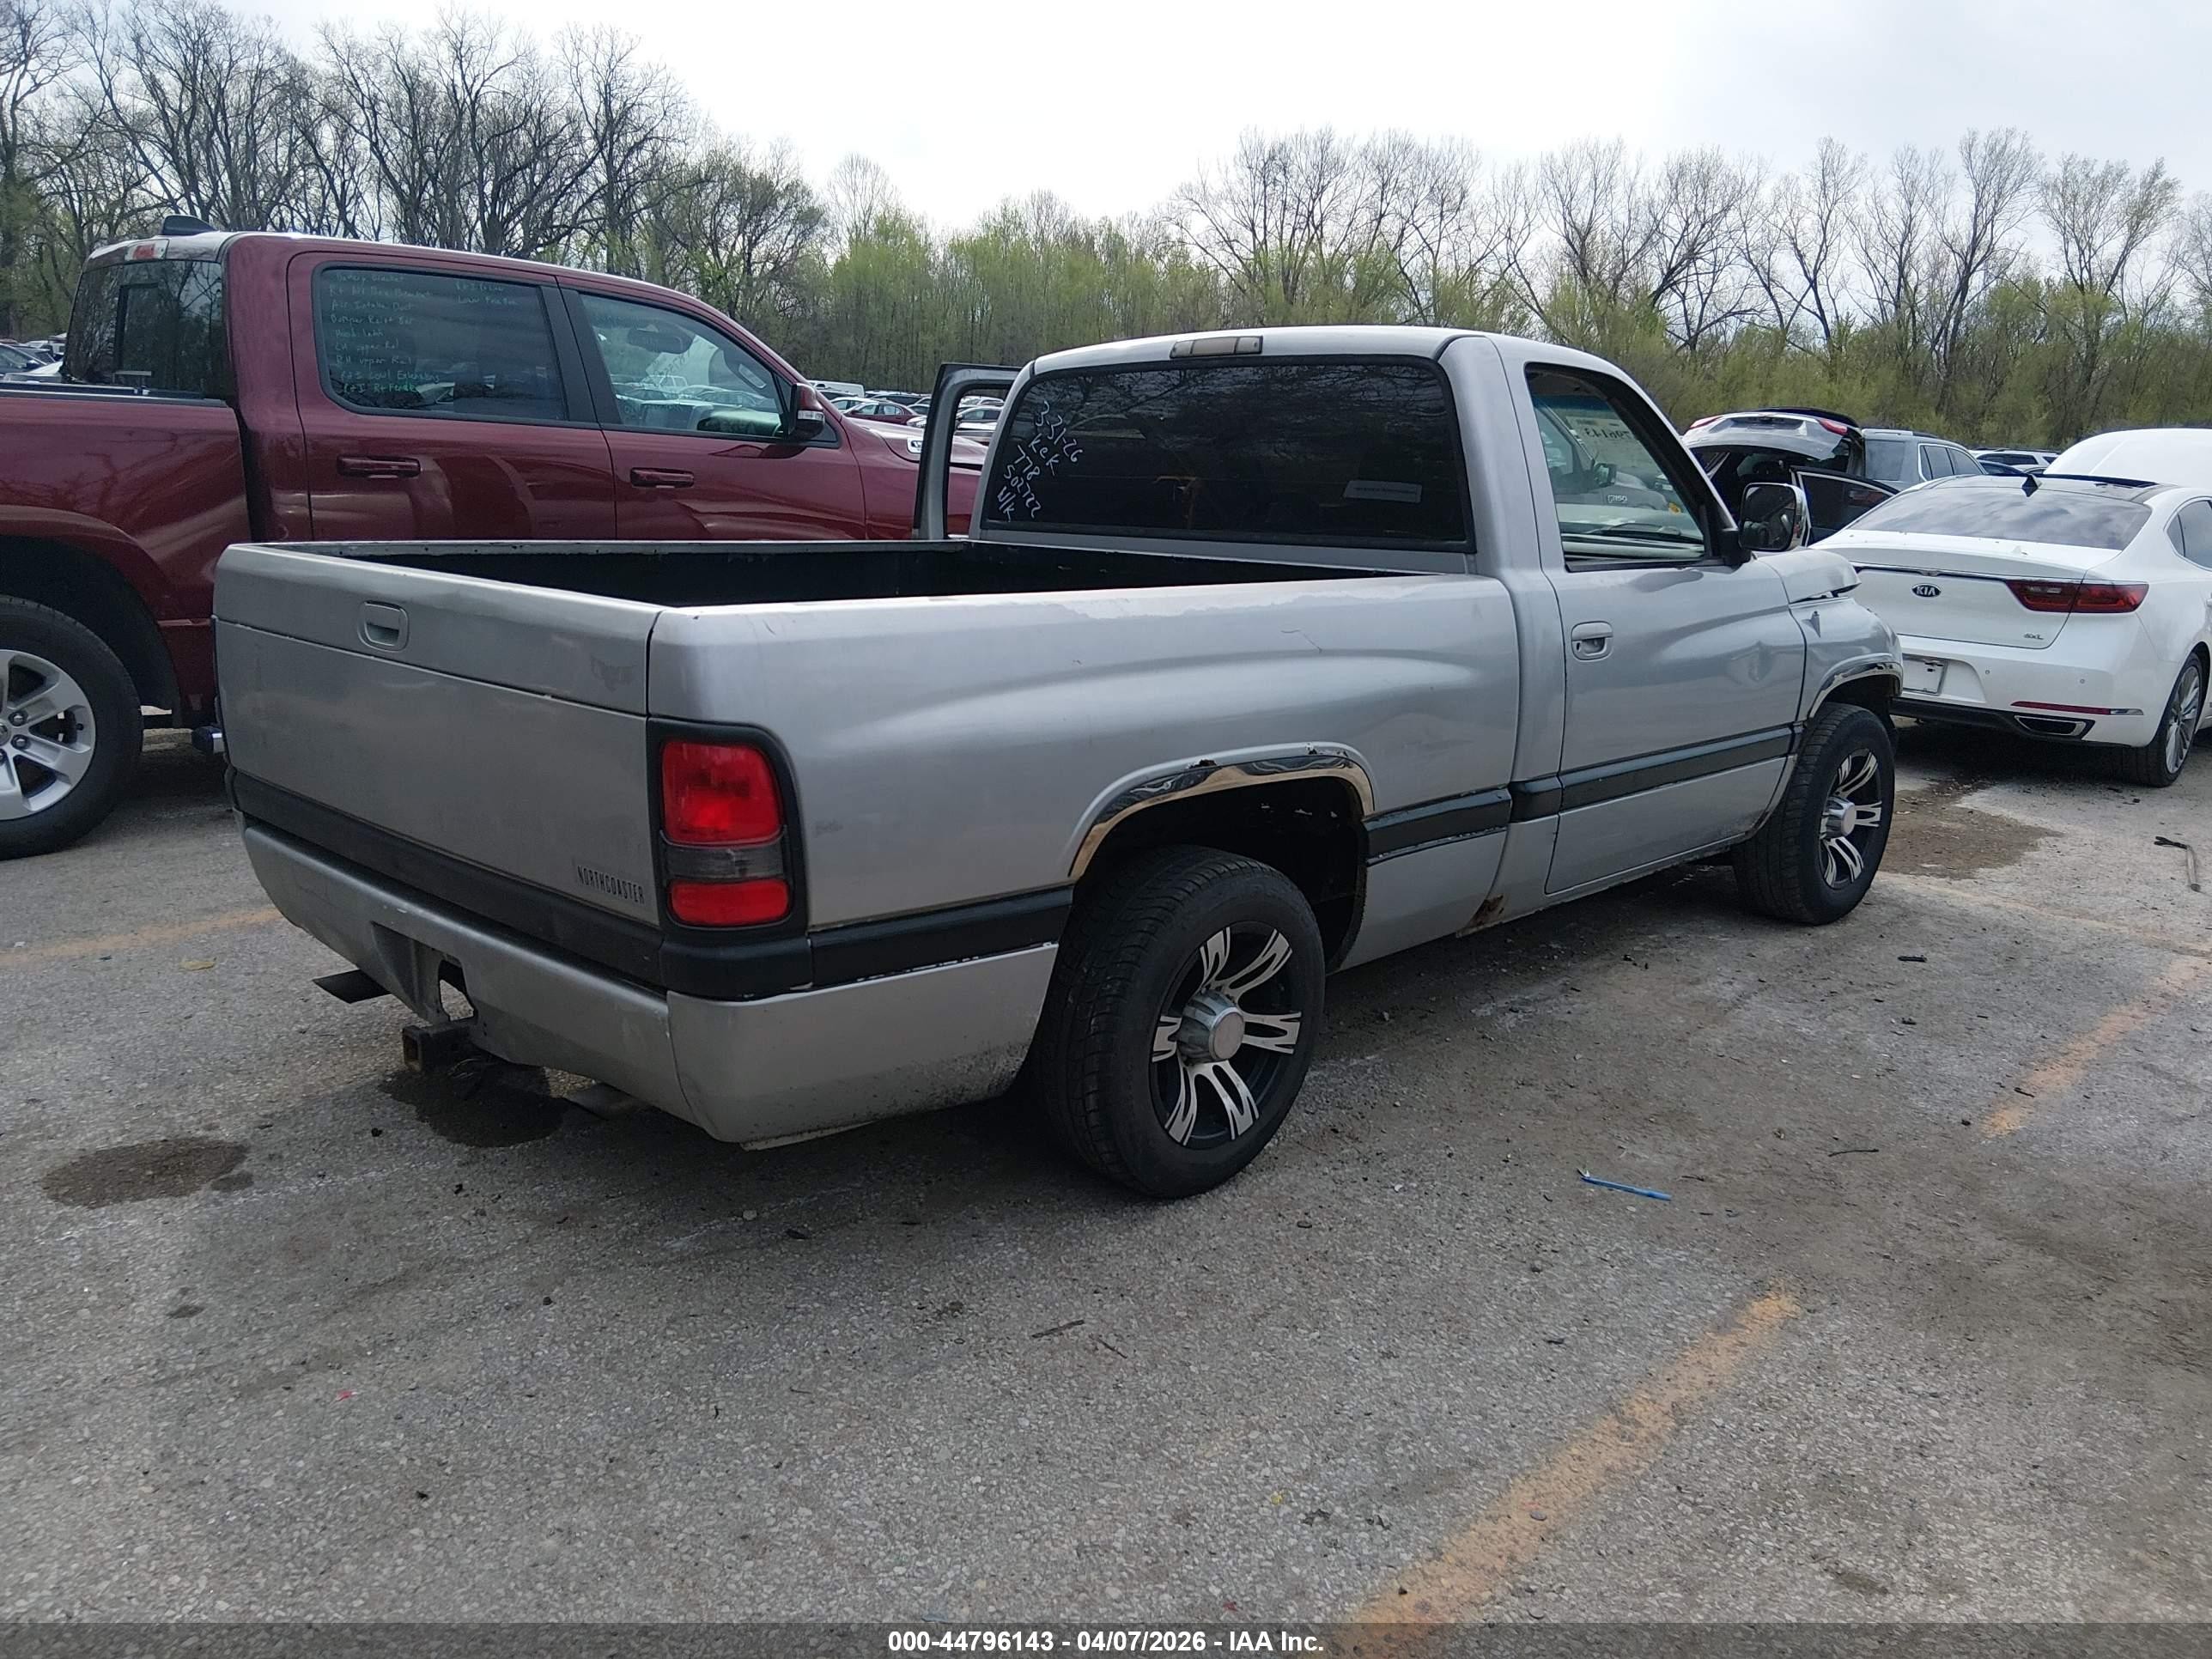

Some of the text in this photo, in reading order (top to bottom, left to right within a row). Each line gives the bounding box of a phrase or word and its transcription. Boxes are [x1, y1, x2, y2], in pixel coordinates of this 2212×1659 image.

[1035, 399, 1084, 463] 3-31-26
[1014, 444, 1041, 481] 778
[576, 864, 646, 905] NORTHCOASTER
